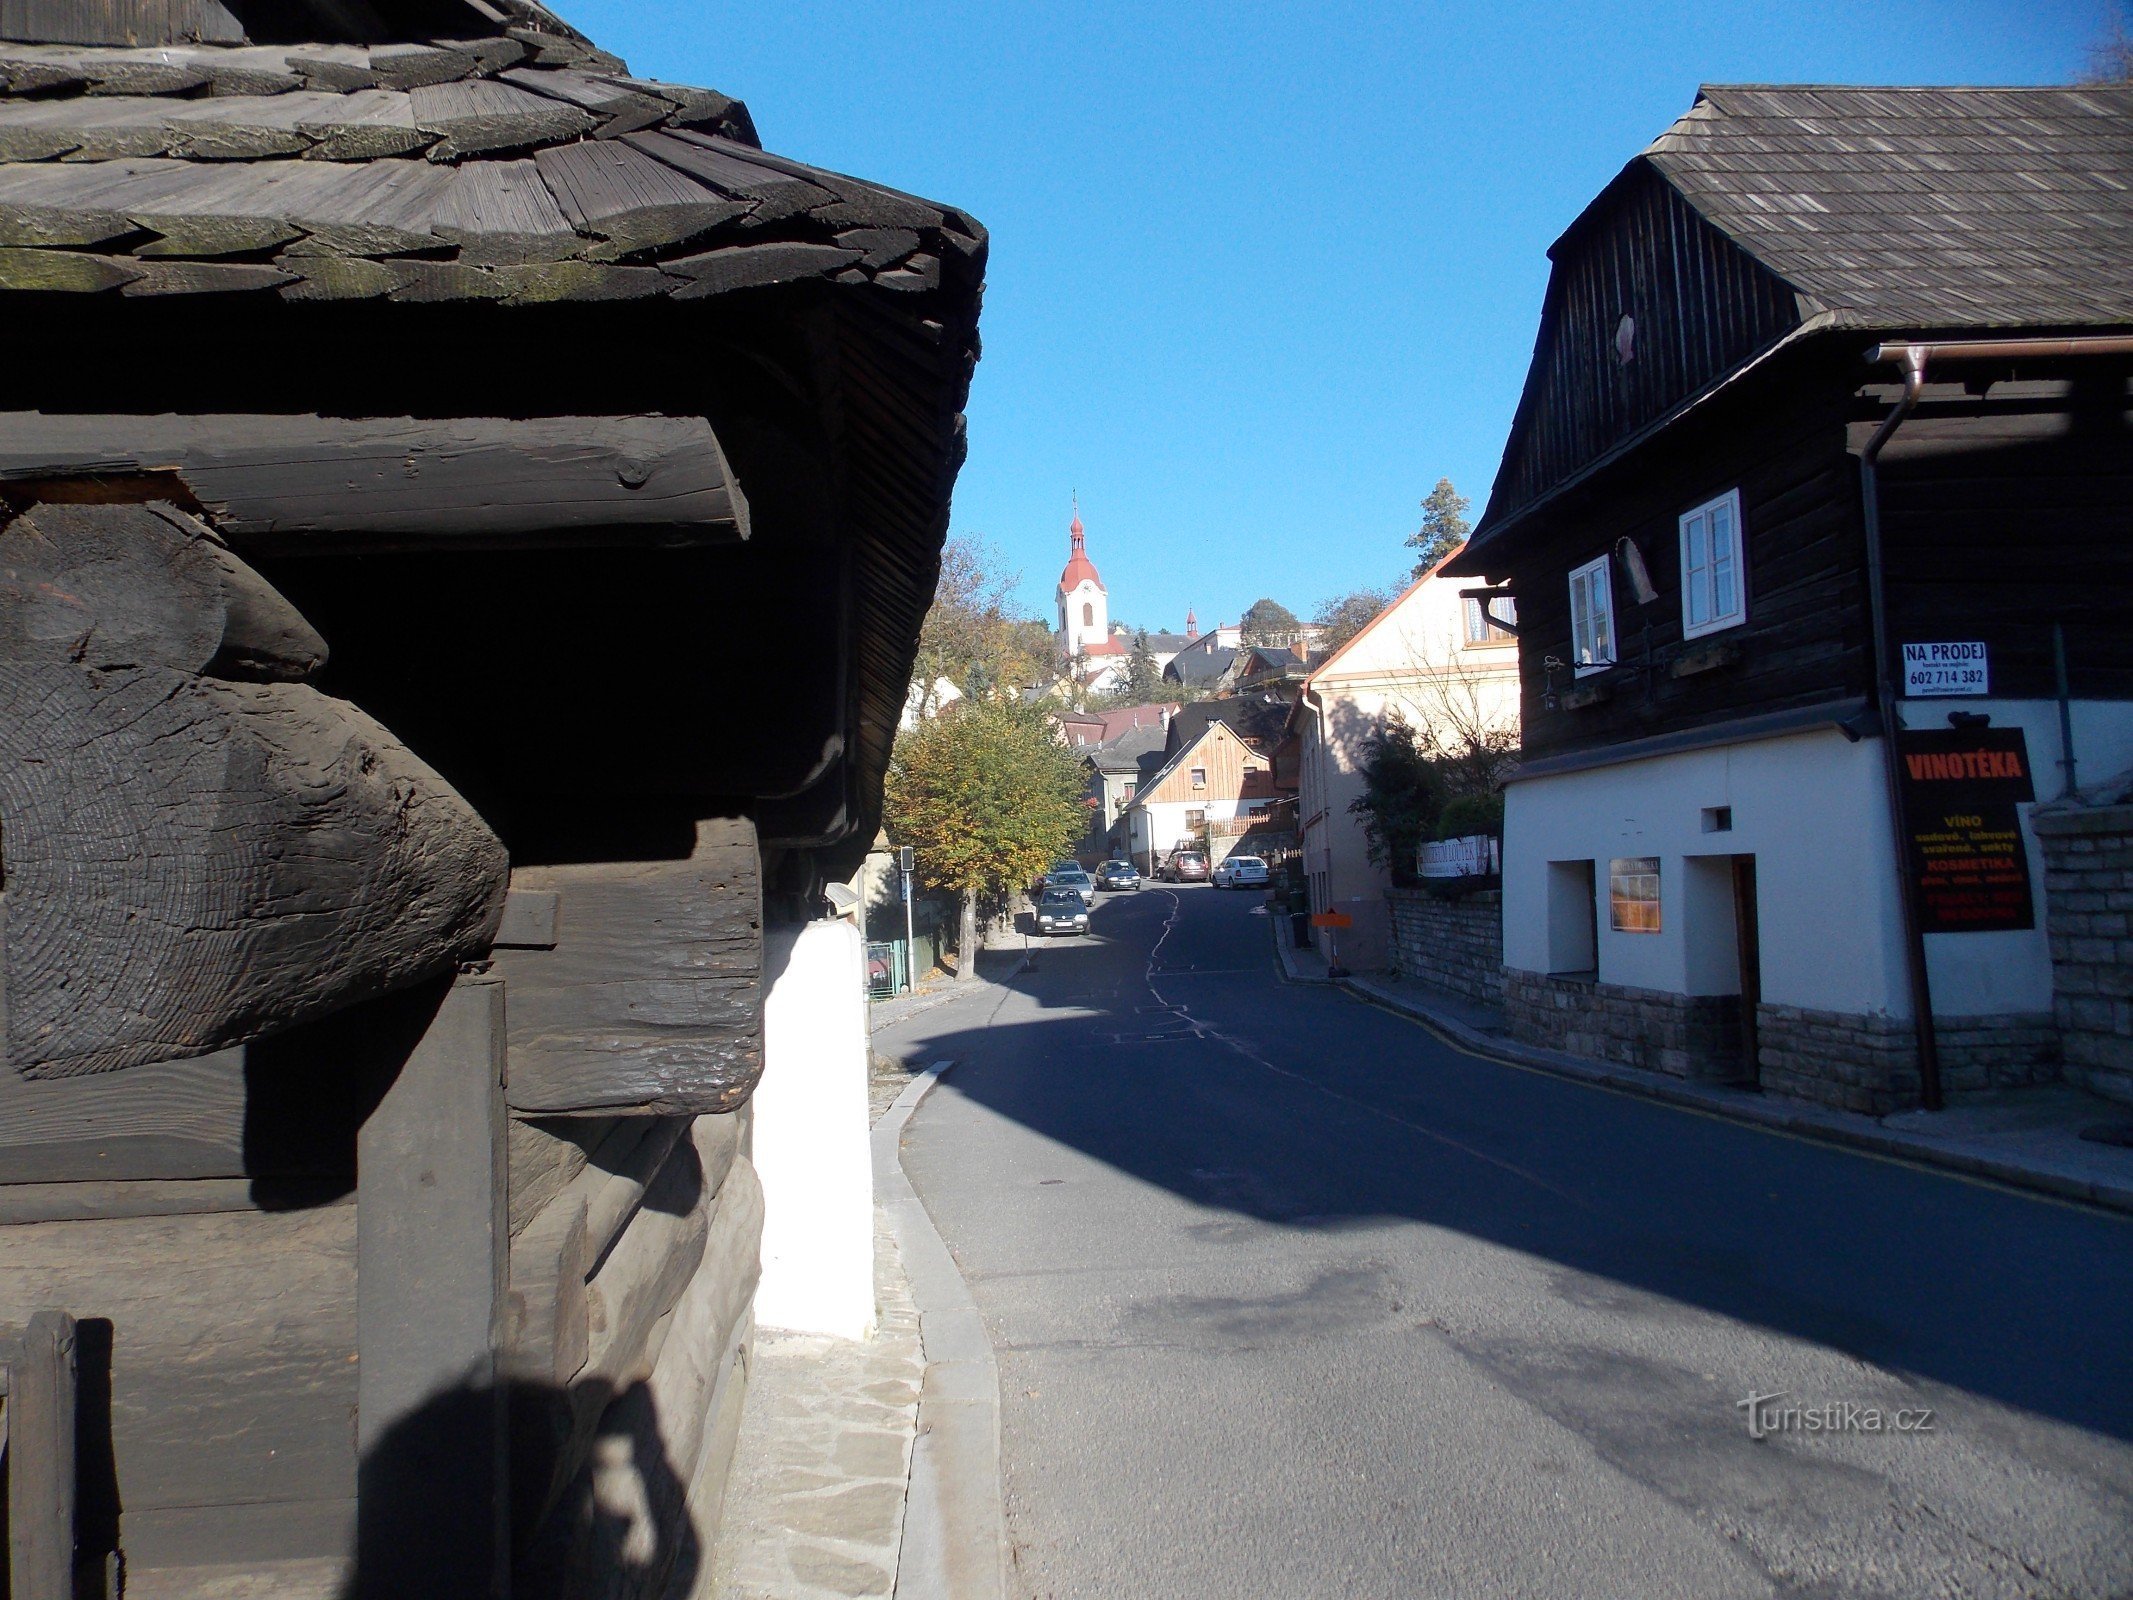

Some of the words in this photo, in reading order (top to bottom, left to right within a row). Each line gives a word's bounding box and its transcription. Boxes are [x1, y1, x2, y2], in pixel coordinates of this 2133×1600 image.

[1906, 645, 1927, 661] NA
[1931, 643, 1985, 660] PRODEJ
[1910, 671, 1932, 685] 602
[1936, 670, 1958, 684] 714
[1962, 669, 1983, 683] 382
[1905, 748, 2022, 781] VINOTÉKA
[1944, 814, 1983, 828] VÍNO
[1926, 857, 2016, 872] KOSMETIKA
